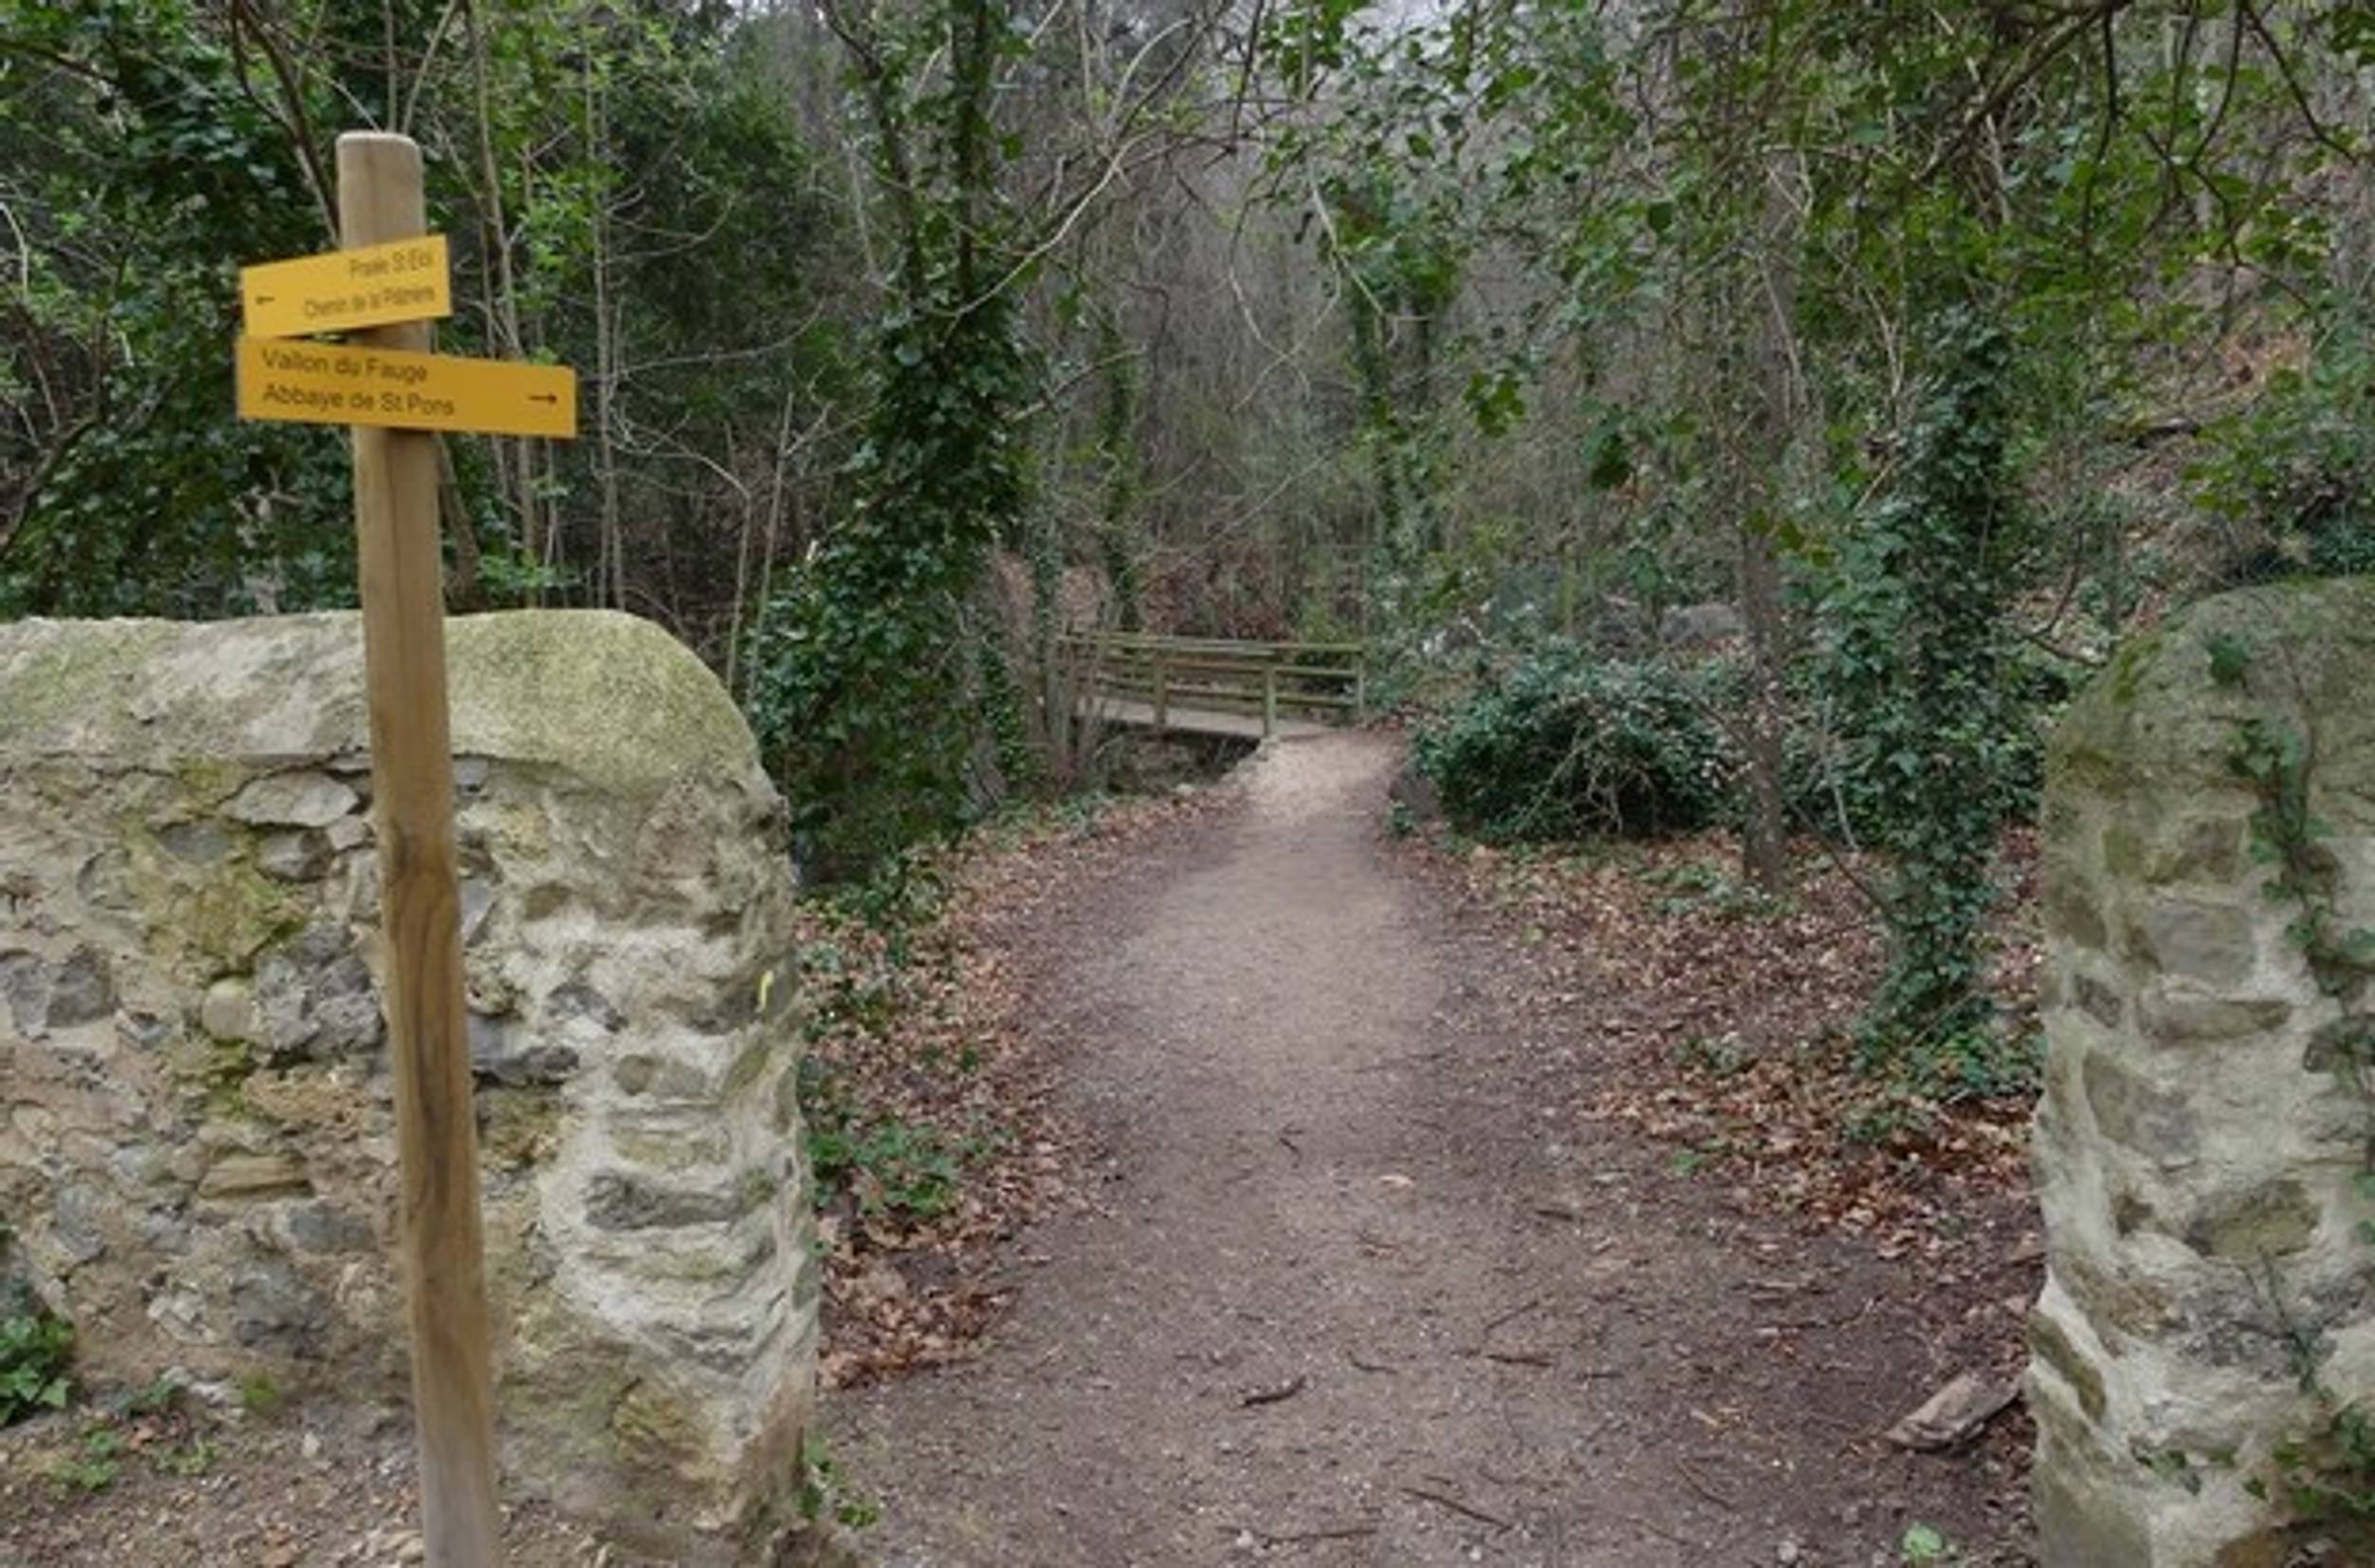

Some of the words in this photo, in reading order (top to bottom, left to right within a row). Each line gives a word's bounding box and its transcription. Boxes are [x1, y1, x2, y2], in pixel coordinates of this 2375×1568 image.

[304, 296, 348, 319] Chemin
[352, 293, 367, 312] de
[262, 348, 329, 373] Vallon
[334, 355, 362, 378] du
[367, 357, 428, 385] Fauge
[262, 382, 344, 411] Abbaye
[350, 390, 374, 410] de
[381, 390, 402, 412] St
[408, 391, 455, 416] Pons
